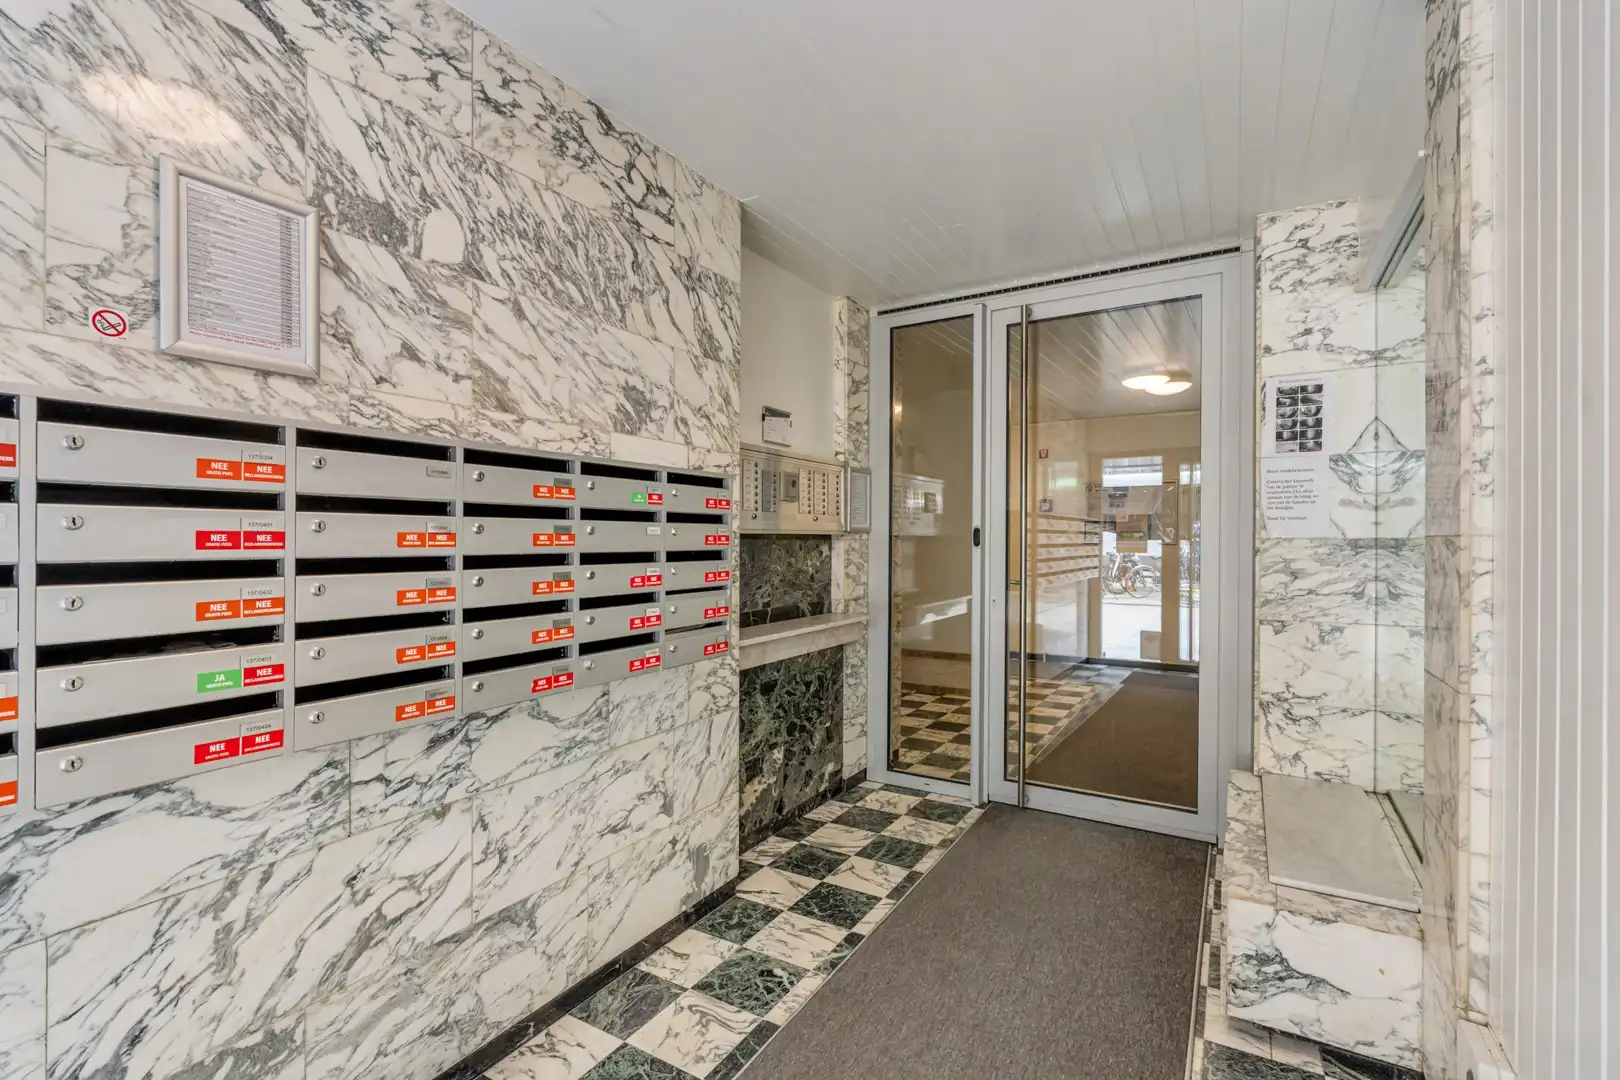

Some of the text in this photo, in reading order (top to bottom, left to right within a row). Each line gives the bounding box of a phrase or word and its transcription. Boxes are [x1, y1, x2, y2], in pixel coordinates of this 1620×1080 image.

[211, 462, 228, 470] NEE
[256, 465, 272, 473] NEE
[210, 603, 228, 612] NEE
[256, 600, 272, 608] NEE
[256, 668, 272, 676] NEE
[214, 674, 225, 682] JA
[255, 734, 270, 744] NEE
[209, 742, 226, 752] NEE
